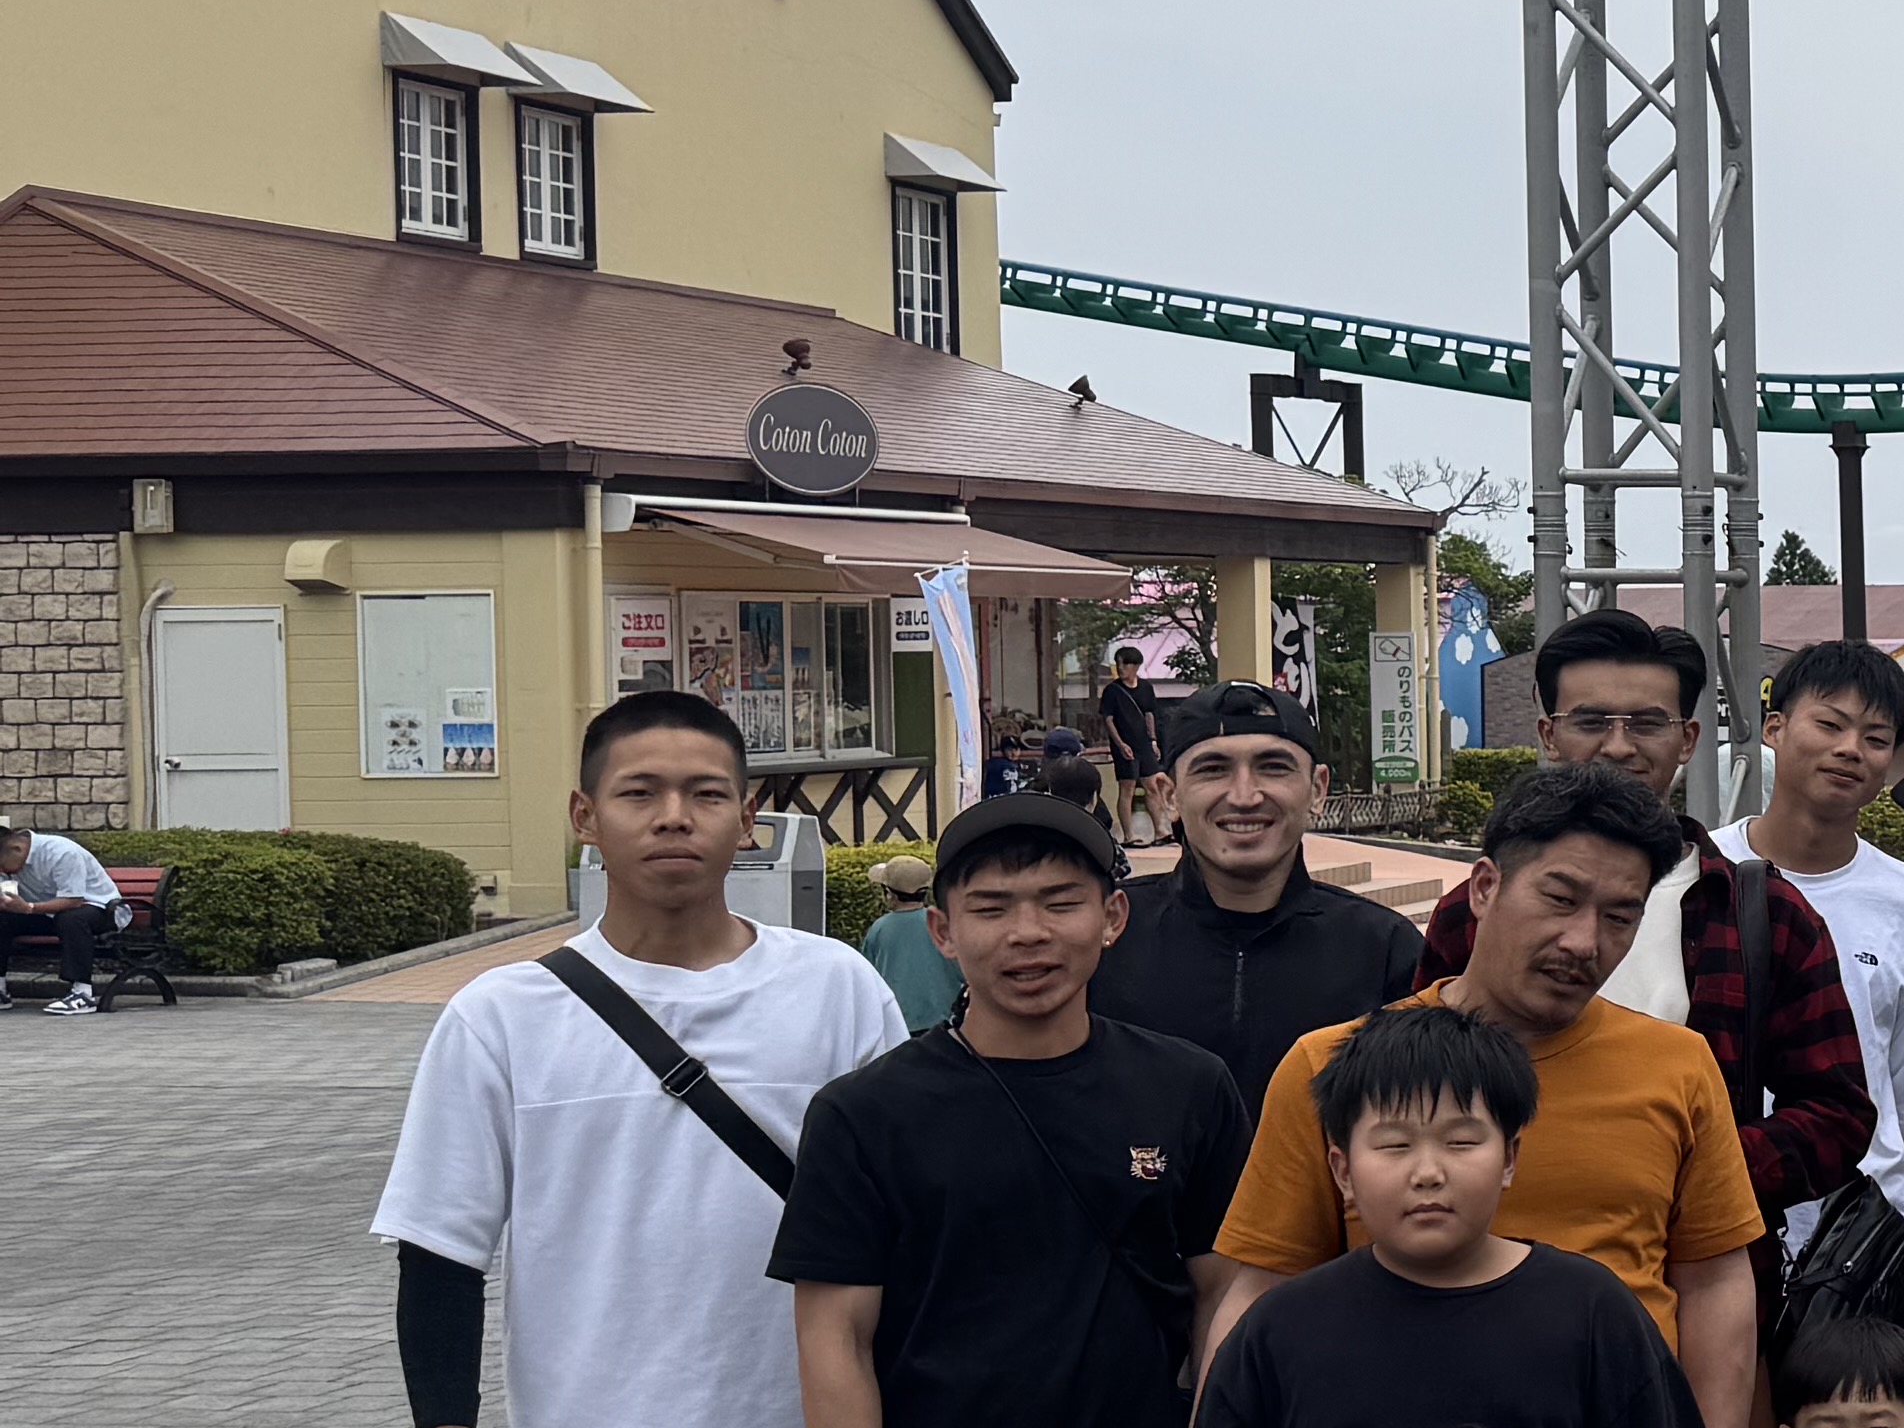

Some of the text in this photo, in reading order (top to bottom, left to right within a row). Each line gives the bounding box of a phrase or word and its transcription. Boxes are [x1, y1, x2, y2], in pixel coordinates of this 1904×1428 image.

[759, 413, 867, 458] Coton Coton
[622, 612, 665, 631] ご注文口
[895, 610, 929, 627] お渡し口
